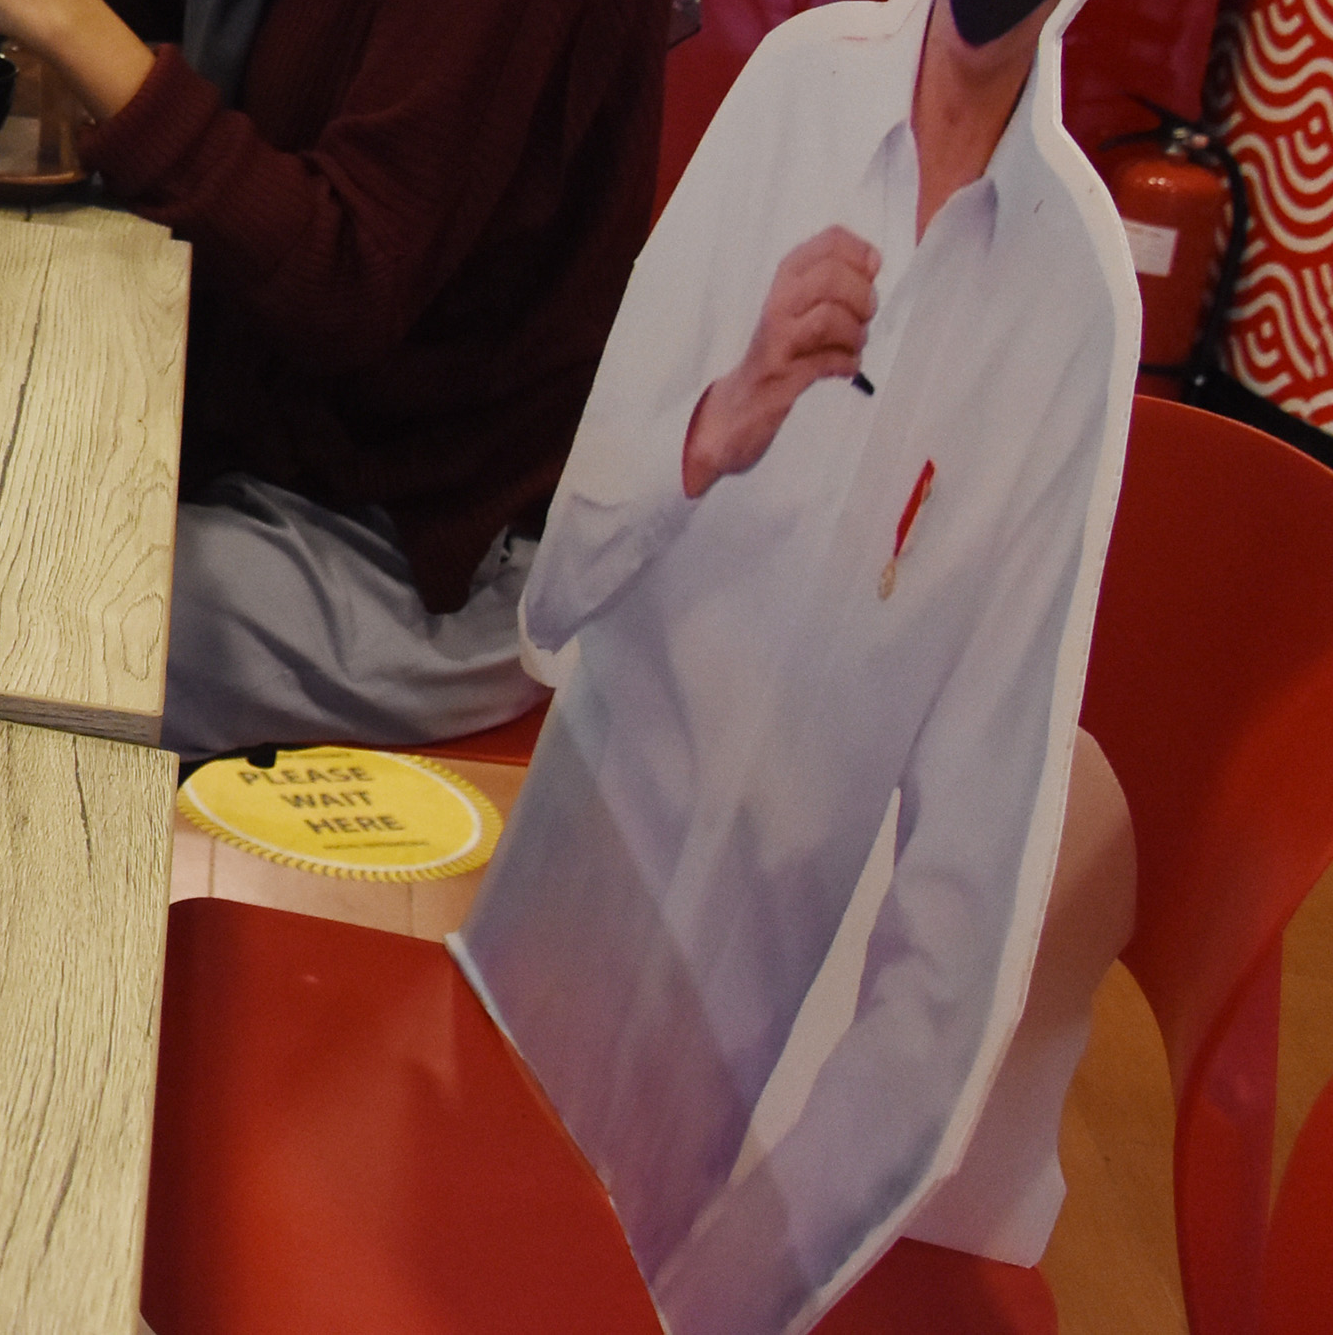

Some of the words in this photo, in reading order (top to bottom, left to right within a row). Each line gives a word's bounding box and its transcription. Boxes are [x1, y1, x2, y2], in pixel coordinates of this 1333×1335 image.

[237, 765, 374, 786] PLEASE
[279, 789, 373, 810] WAIT
[303, 814, 405, 835] HERE
